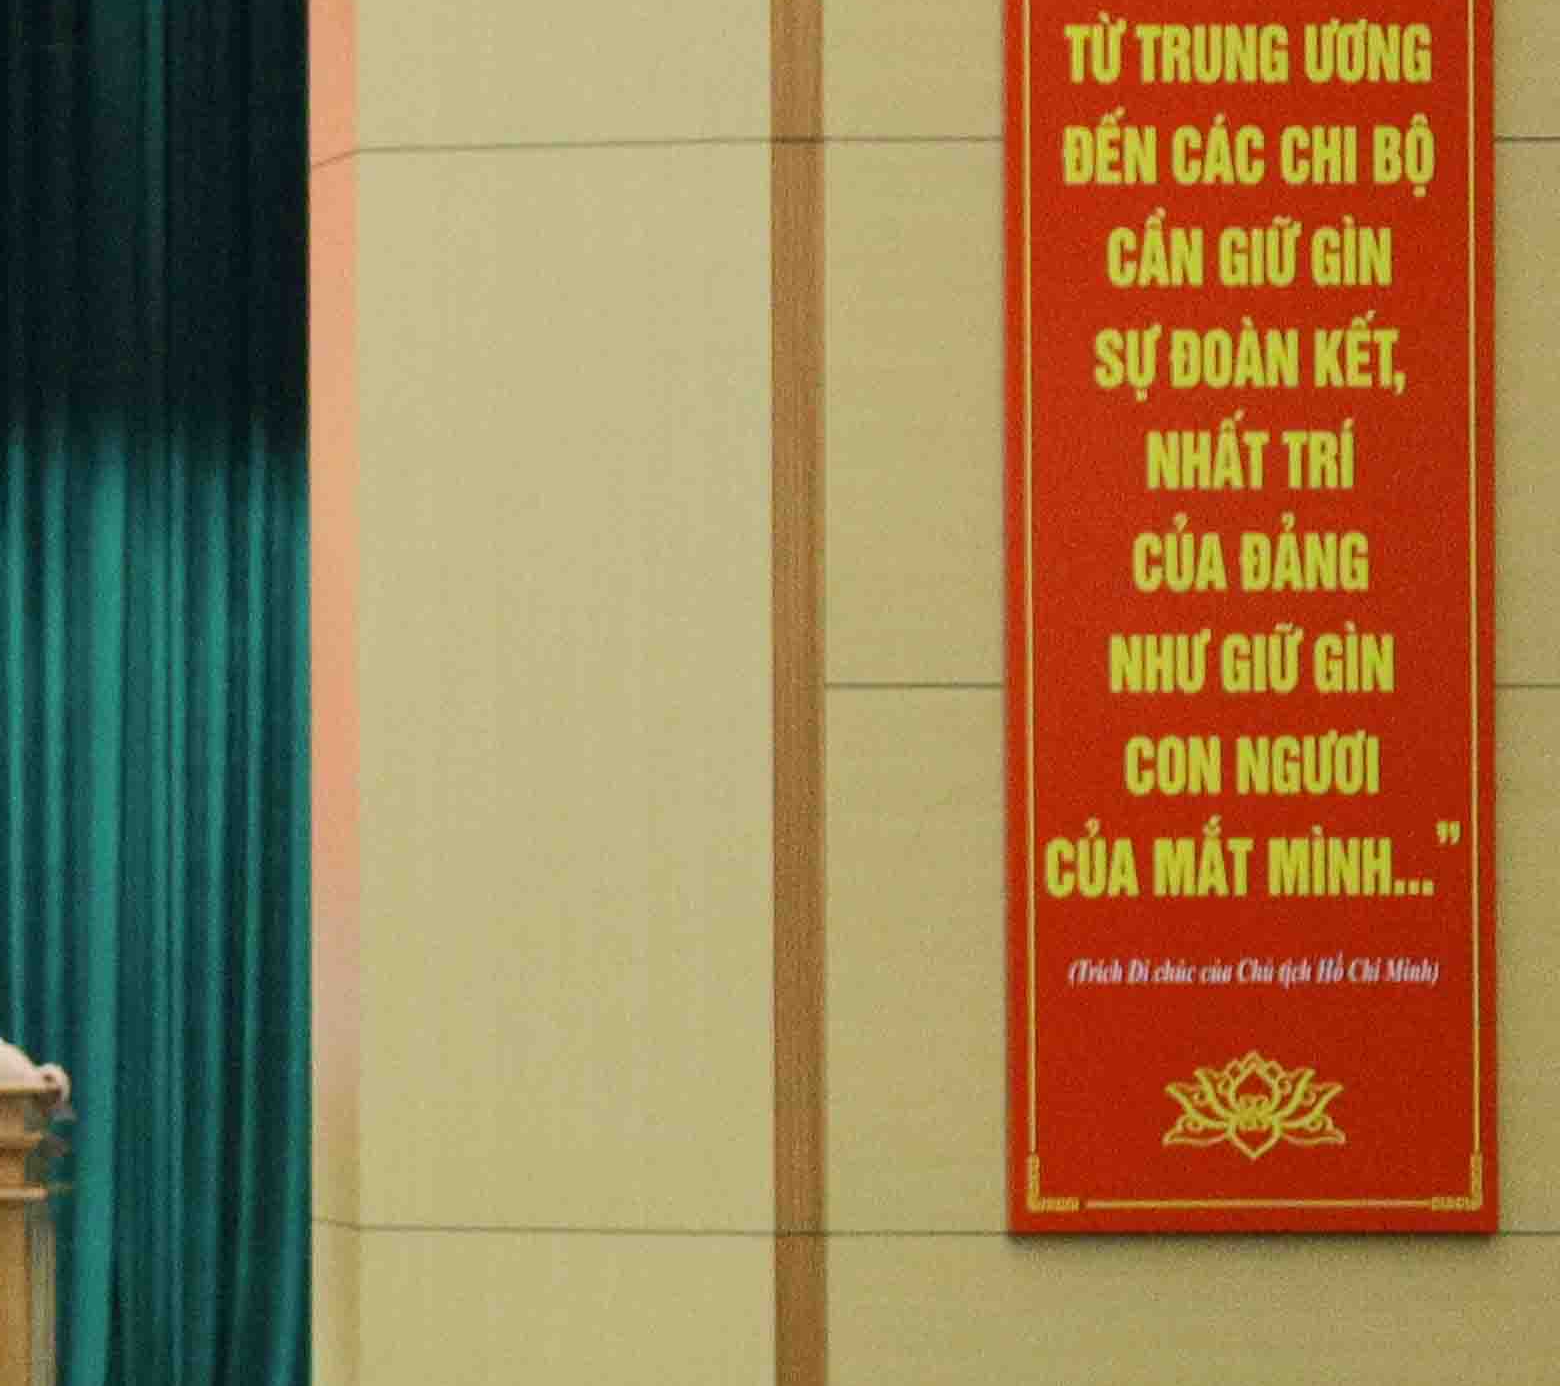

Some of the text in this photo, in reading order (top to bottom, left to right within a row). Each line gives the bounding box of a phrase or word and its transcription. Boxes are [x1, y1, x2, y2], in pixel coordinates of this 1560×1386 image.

[1064, 12, 1431, 83] TỪ TRUNG ƯƠNG
[1063, 108, 1434, 196] ĐẾN CÁC CHI BỘ
[1095, 311, 1405, 401] SỰ ĐOÀN KẾT,
[1147, 411, 1353, 489] NHẤT TRÍ
[1045, 819, 1138, 897] CỦA
[1154, 816, 1253, 895] MẮT
